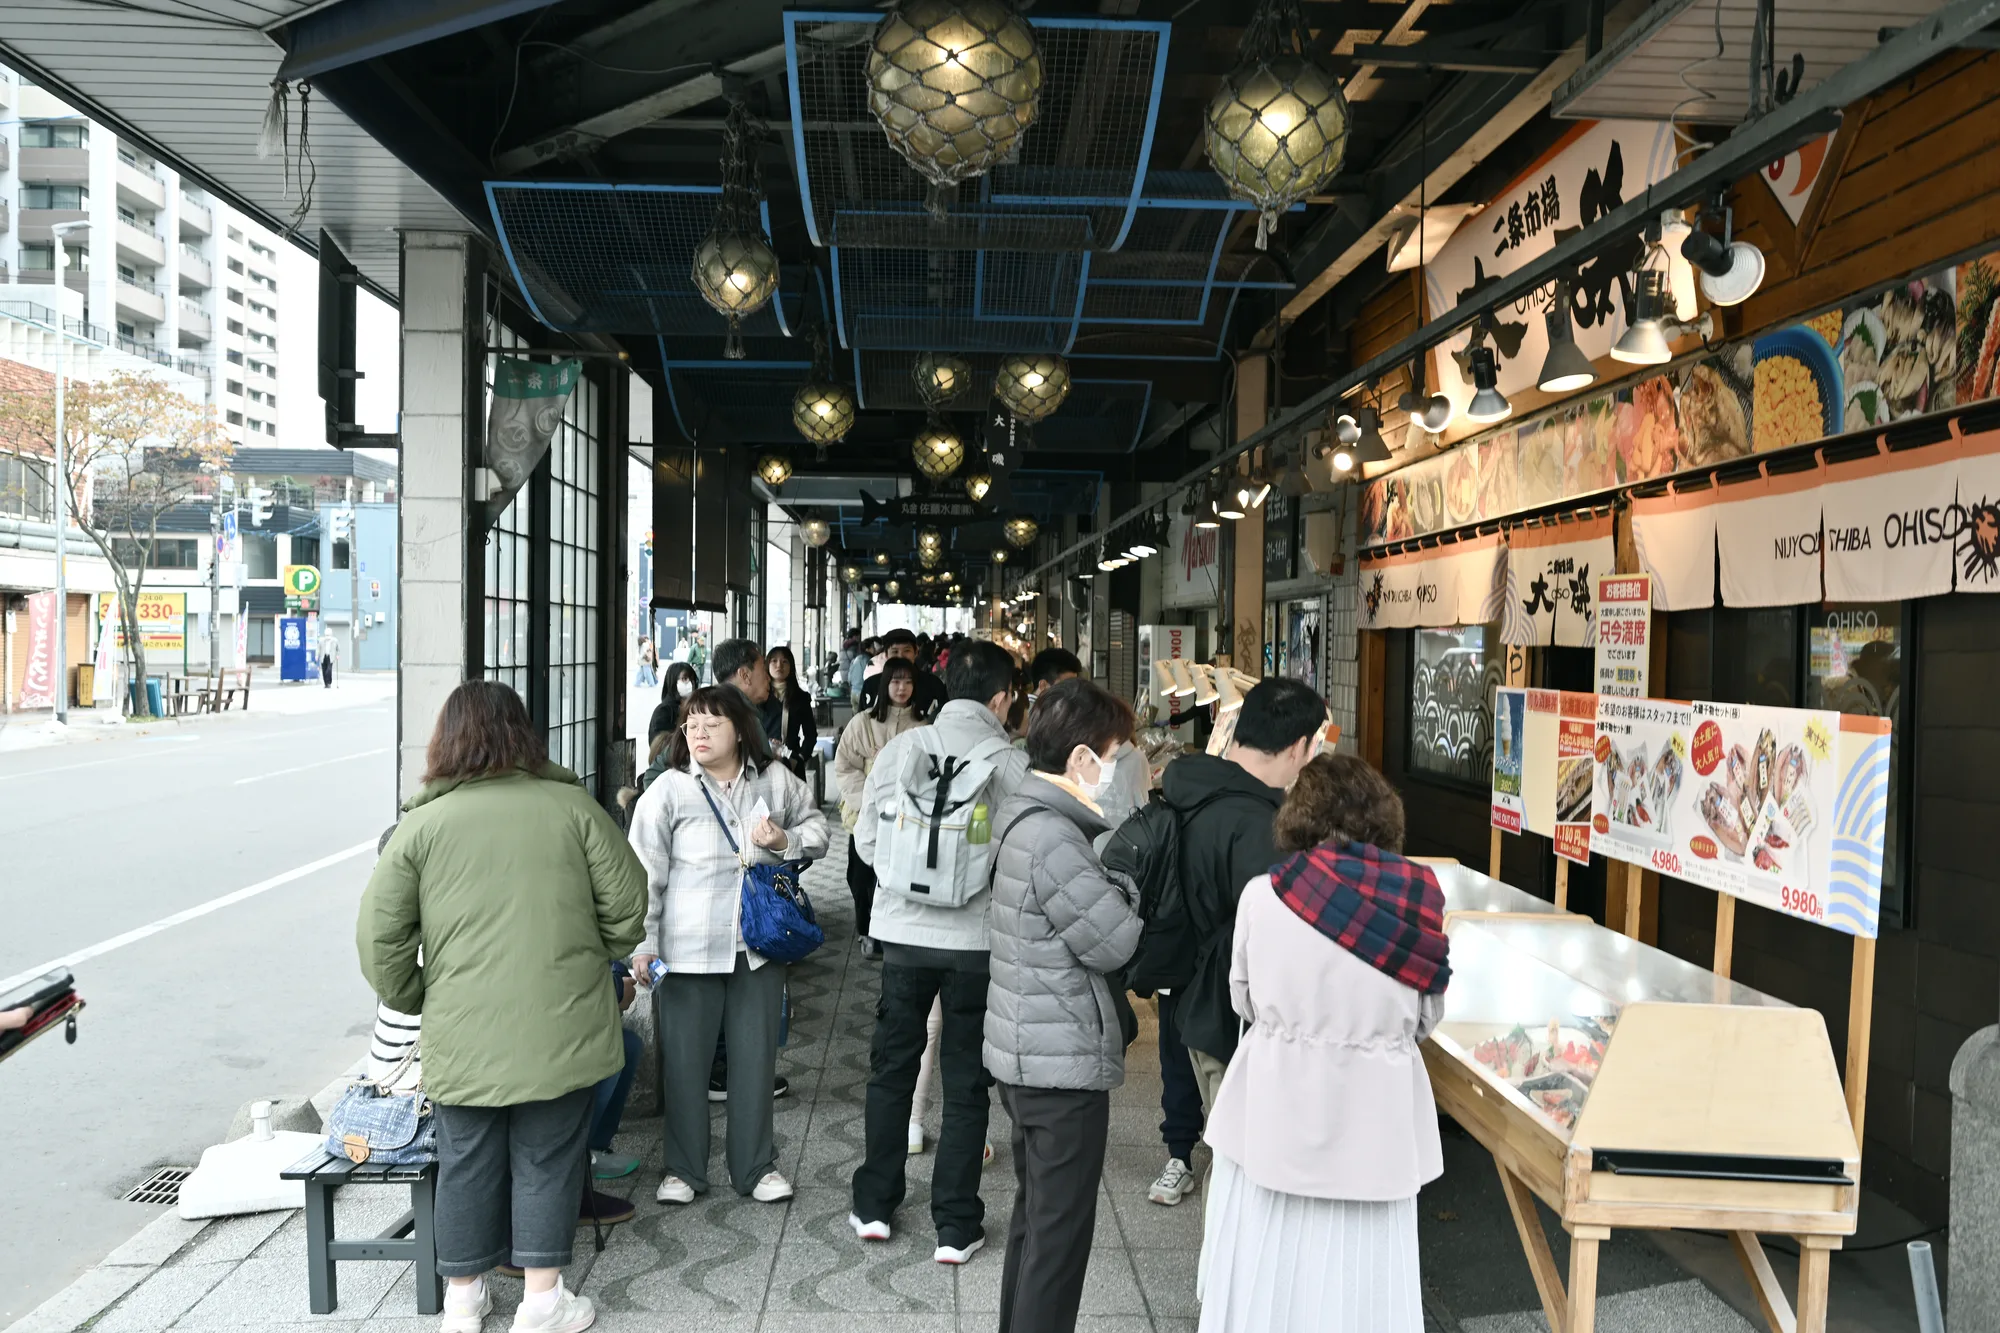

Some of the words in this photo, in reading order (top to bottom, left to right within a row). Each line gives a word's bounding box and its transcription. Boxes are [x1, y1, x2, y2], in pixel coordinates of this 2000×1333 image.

[1493, 174, 1560, 258] 二条市場
[1884, 503, 1968, 548] OHISO
[1606, 581, 1641, 599] お客様各位
[1599, 620, 1646, 645] 只今満席
[1827, 610, 1879, 633] OHISO
[1607, 648, 1636, 661] でございます
[1693, 723, 1719, 749] お土産に
[1695, 746, 1720, 772] 大人気!!
[1502, 812, 1511, 825] OUT
